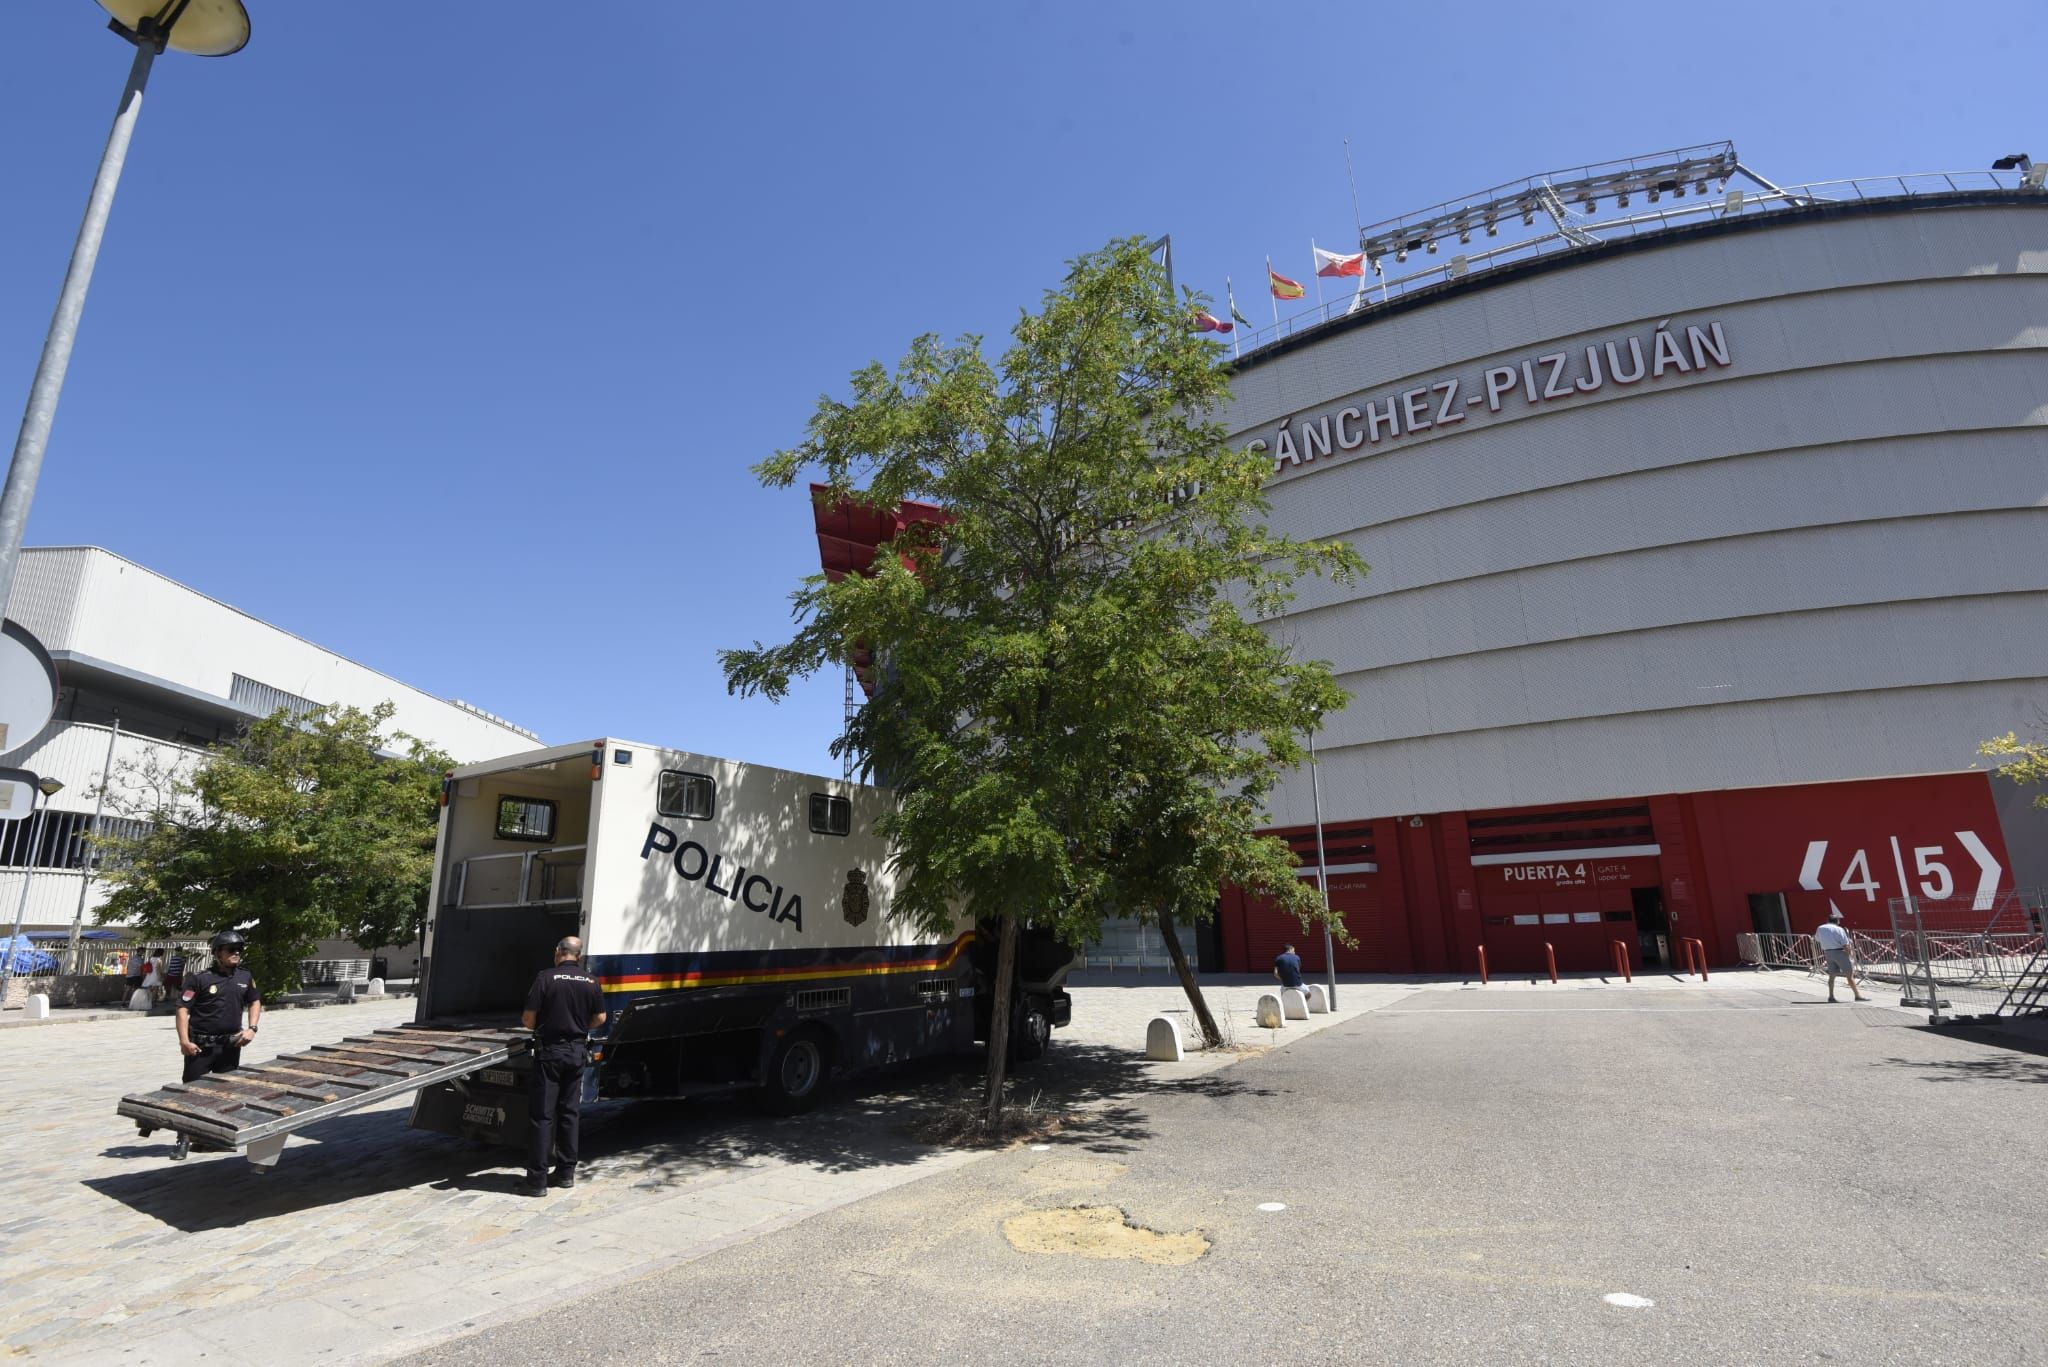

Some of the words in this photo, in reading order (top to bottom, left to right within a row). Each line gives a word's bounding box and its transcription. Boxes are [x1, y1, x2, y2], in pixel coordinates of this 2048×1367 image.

[640, 821, 803, 933] POLICIA
[1503, 864, 1570, 881] PUERTA
[1574, 863, 1586, 878] 4
[1839, 849, 1881, 902] 4
[1914, 845, 1954, 900] 5
[553, 974, 591, 983] POLICIA
